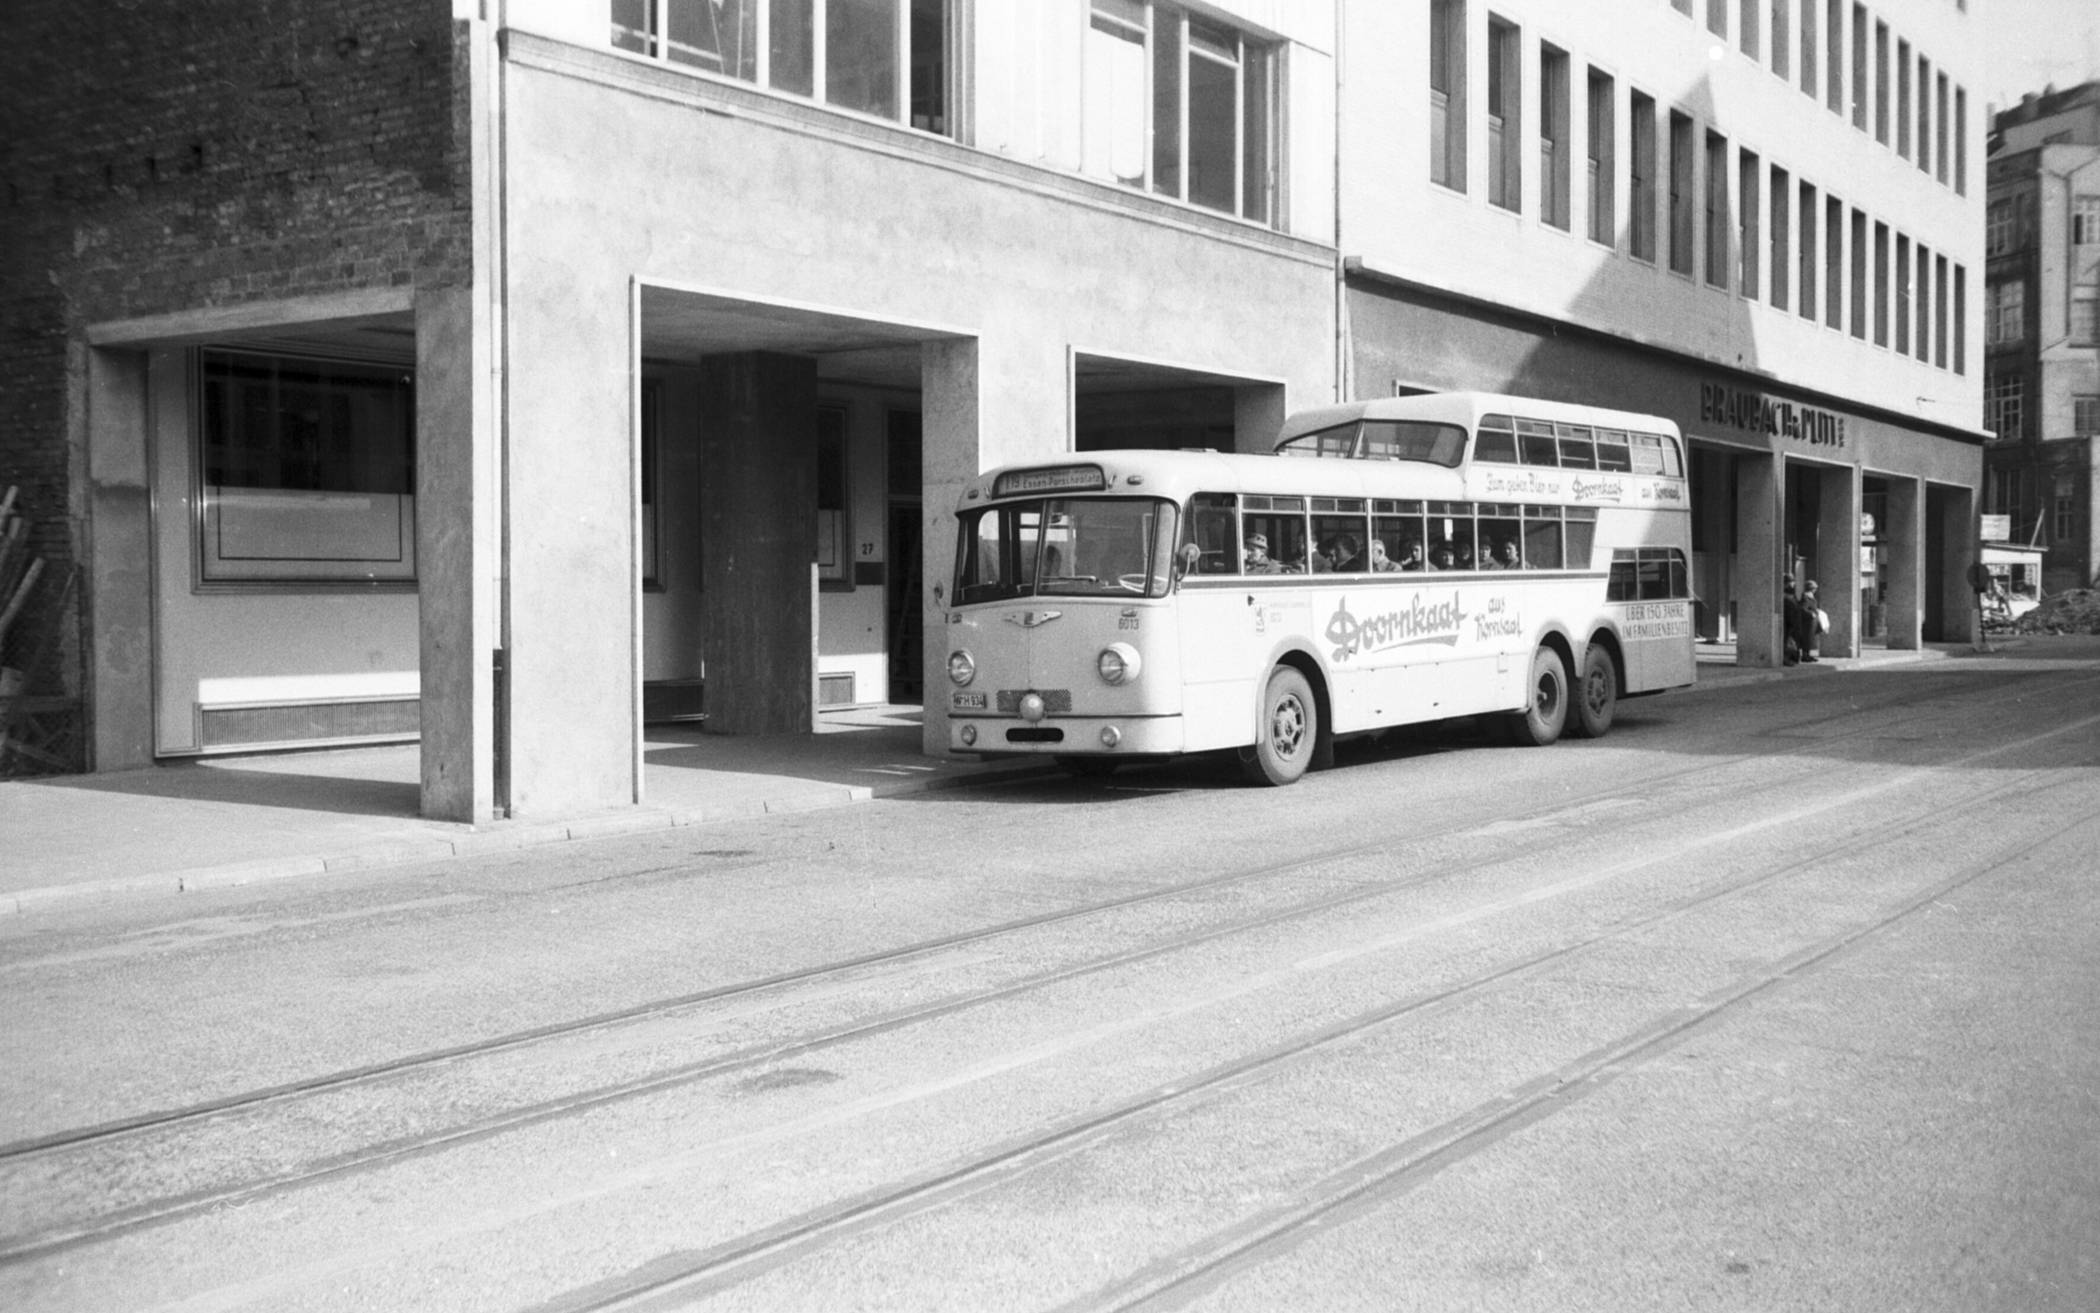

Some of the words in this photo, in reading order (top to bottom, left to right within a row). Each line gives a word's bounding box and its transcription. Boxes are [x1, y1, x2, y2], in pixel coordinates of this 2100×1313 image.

[1701, 383, 1792, 437] BRAUBACH
[1572, 475, 1623, 501] Doornkaat
[862, 543, 873, 555] 27
[1325, 591, 1467, 662] Doornkaat
